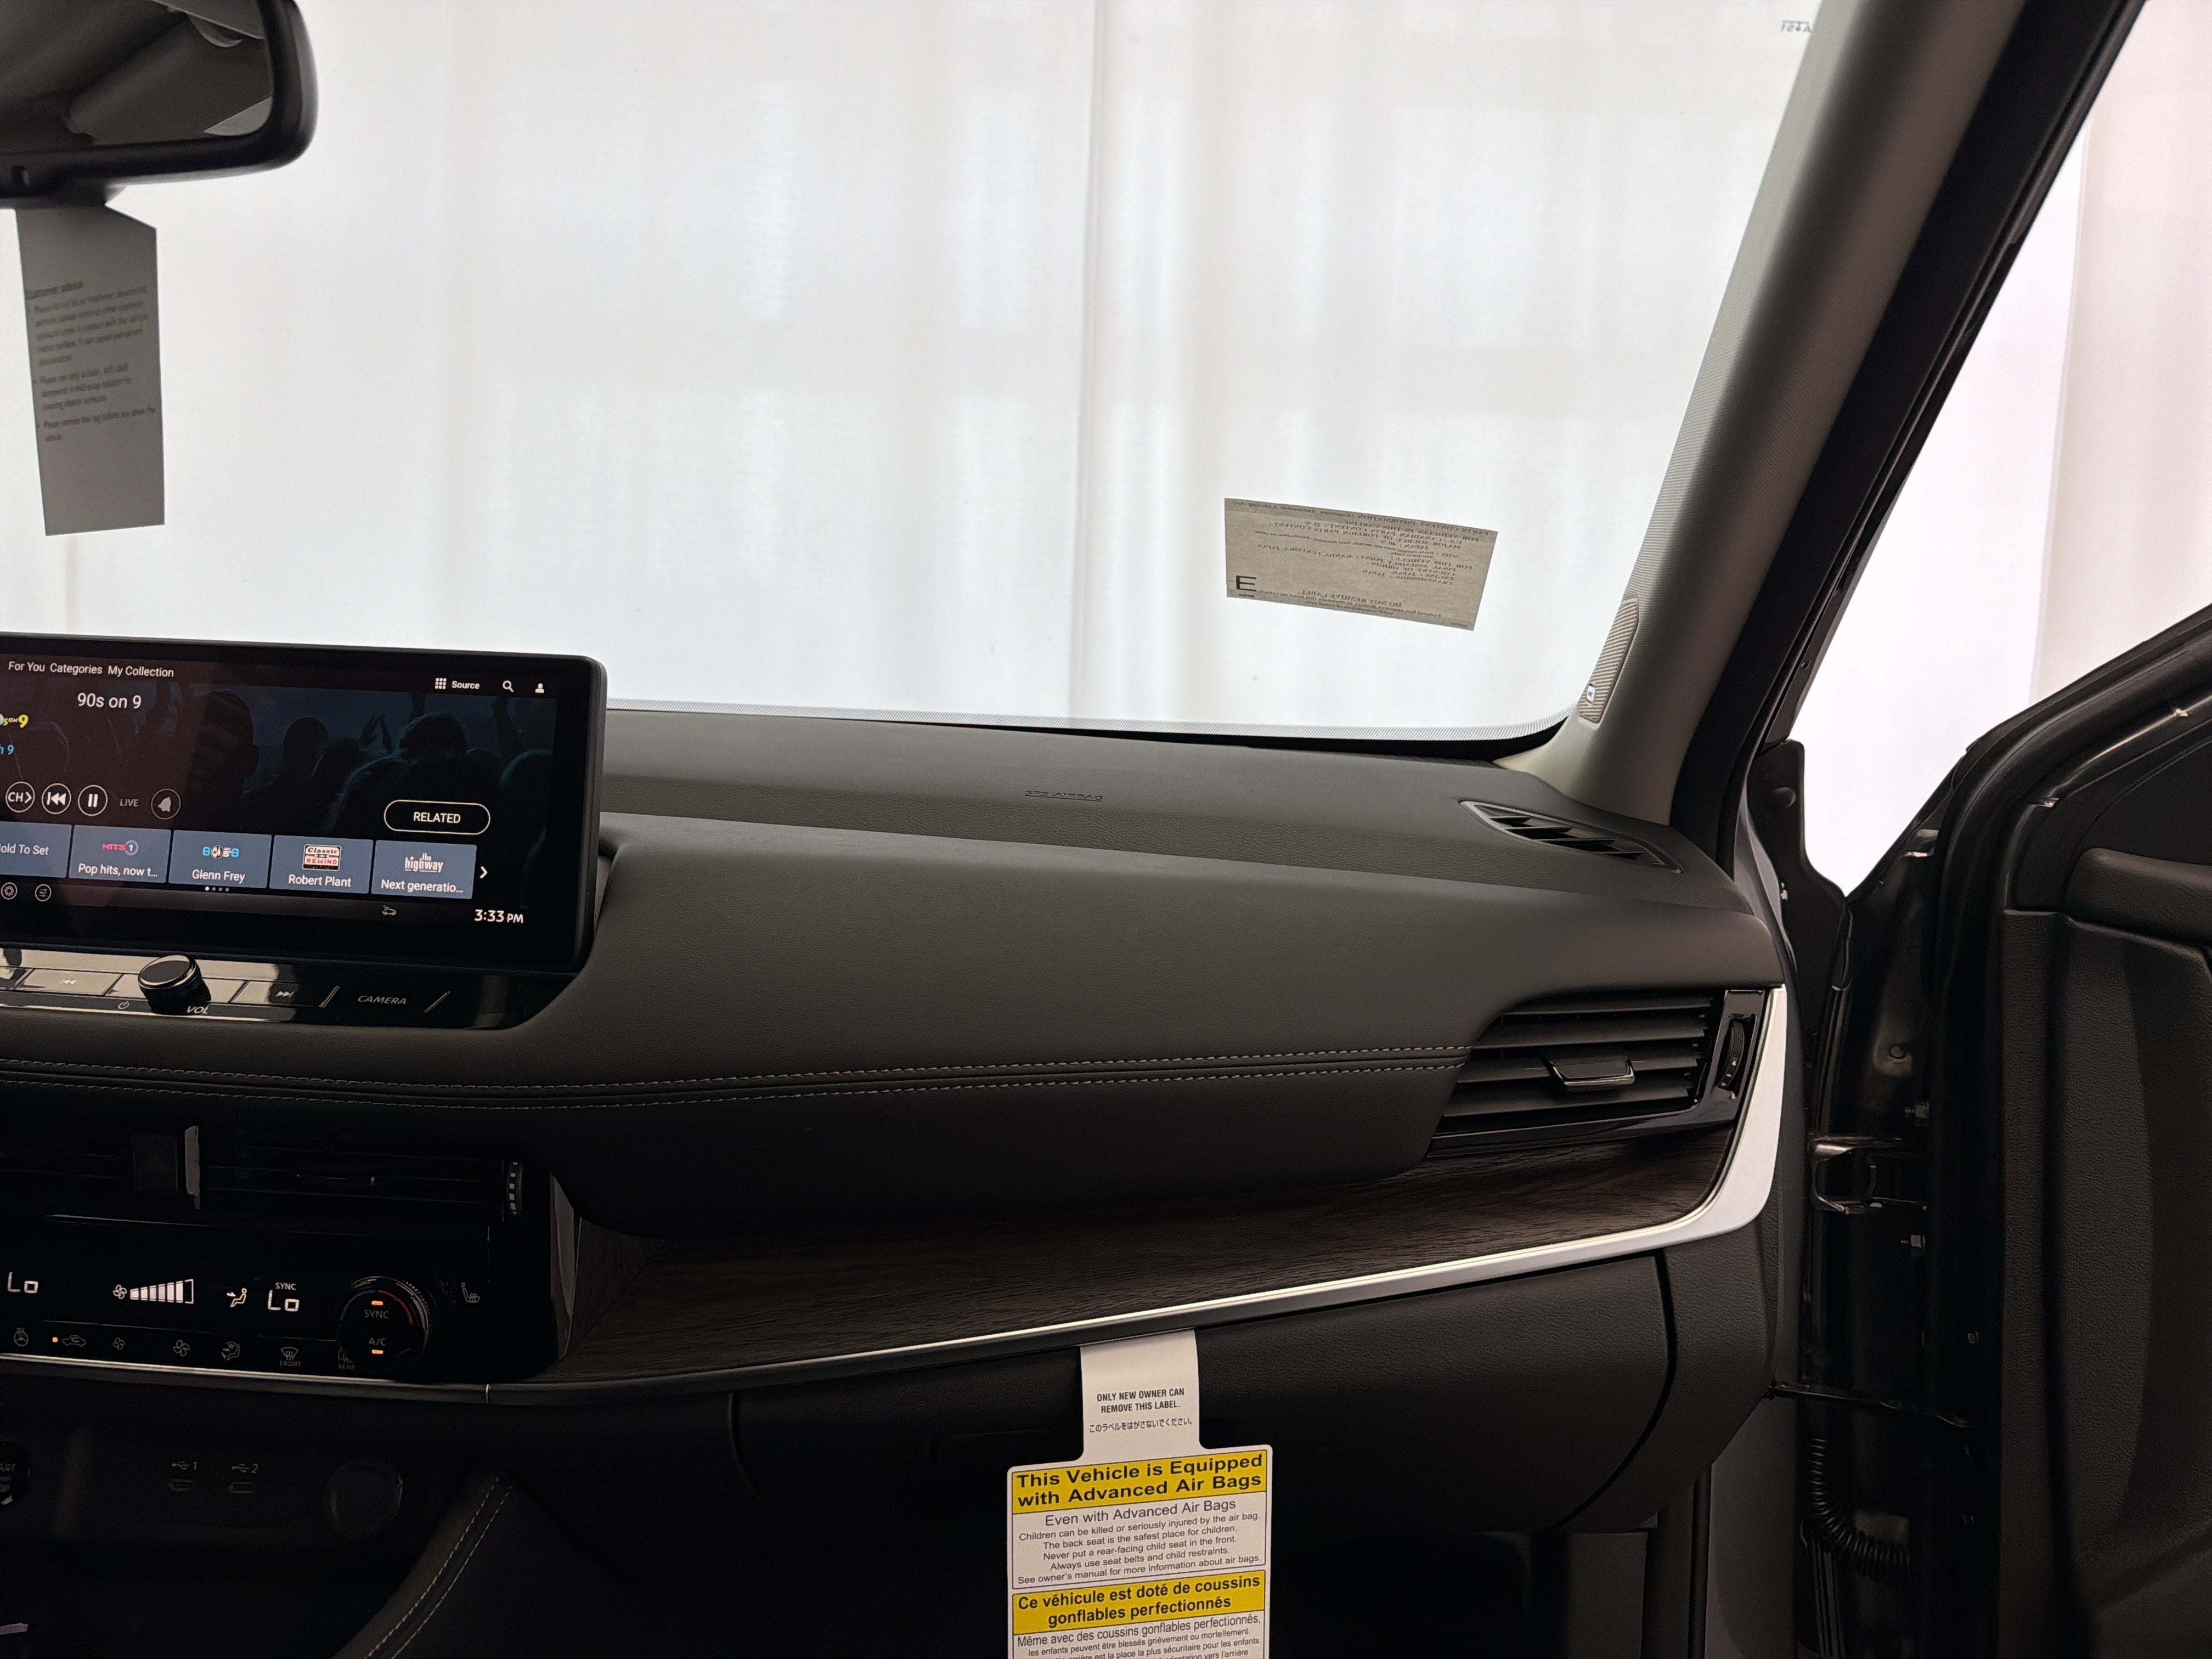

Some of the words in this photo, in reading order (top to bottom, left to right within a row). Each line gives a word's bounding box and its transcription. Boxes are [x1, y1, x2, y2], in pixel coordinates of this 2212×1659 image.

[8, 661, 24, 671] For
[27, 662, 45, 672] You
[50, 663, 103, 675] Categories
[108, 665, 123, 678] My
[125, 666, 174, 677] Collection
[452, 680, 479, 691] Source
[78, 693, 104, 707] 90s
[109, 697, 127, 708] on
[132, 695, 142, 709] 9
[7, 744, 14, 754] 9
[8, 792, 24, 803] CH
[120, 799, 139, 807] LIVE
[413, 811, 461, 823] RELATED
[0, 843, 16, 853] old
[19, 844, 30, 854] To
[33, 845, 49, 855] Set
[422, 853, 432, 861] the
[78, 864, 97, 876] Pop
[100, 864, 121, 876] hits,
[123, 868, 144, 876] now
[405, 856, 443, 873] highway
[192, 869, 221, 880] Glenn
[224, 871, 245, 884] Frey
[289, 874, 322, 885] Robert
[325, 876, 351, 887] Plant
[381, 879, 405, 890] Next
[475, 909, 504, 922] 3:33
[507, 913, 523, 923] PM
[358, 995, 407, 1005] CAMERA
[187, 1006, 209, 1014] VOL
[275, 1282, 297, 1290] SYNC
[364, 1310, 389, 1319] SYNC
[369, 1338, 387, 1346] A/C
[1097, 1392, 1116, 1401] ONLY
[1119, 1391, 1136, 1400] NEW
[1139, 1389, 1166, 1398] OWNER
[1170, 1387, 1184, 1396] CAN
[1101, 1403, 1132, 1413] REMOVE
[1135, 1402, 1152, 1410] THIS
[1155, 1400, 1181, 1409] LABEL.
[1017, 1473, 1060, 1487] This
[1066, 1465, 1139, 1483] Vehicle
[1147, 1464, 1163, 1476] is
[1170, 1454, 1262, 1475] Equipped
[1018, 1491, 1059, 1506] with
[1068, 1481, 1167, 1502] Advanced
[1176, 1479, 1204, 1492] Air
[1213, 1475, 1261, 1489] Bags
[1045, 1515, 1078, 1526] Even
[1082, 1511, 1108, 1522] with
[1113, 1504, 1177, 1520] Advanced
[1182, 1502, 1200, 1514] Air
[1204, 1500, 1235, 1512] Bags
[1019, 1532, 1056, 1541] Children
[1092, 1525, 1113, 1534] killed
[1128, 1521, 1166, 1531] seriously
[1169, 1517, 1197, 1528] injured
[1200, 1515, 1210, 1525] by
[1213, 1514, 1226, 1522] the
[1063, 1539, 1084, 1548] back
[1134, 1532, 1159, 1541] safest
[1162, 1530, 1184, 1540] place
[1201, 1526, 1237, 1534] children.
[1073, 1550, 1086, 1559] put
[1097, 1545, 1143, 1555] rear-facing
[1169, 1541, 1187, 1549] seat
[1051, 1562, 1081, 1571] Always
[1188, 1547, 1229, 1557] restraints.
[1038, 1573, 1072, 1582] owner's
[1075, 1569, 1107, 1578] manual
[1124, 1566, 1146, 1574] more
[1148, 1561, 1195, 1572] information
[1019, 1596, 1038, 1609] Ce
[1042, 1590, 1104, 1607] véhicule
[1110, 1587, 1132, 1600] est
[1137, 1583, 1168, 1598] doté
[1173, 1582, 1190, 1594] de
[1195, 1576, 1260, 1592] coussins
[1048, 1607, 1126, 1628] gonflables
[1131, 1596, 1231, 1620] perfectionnés
[1018, 1635, 1048, 1647] Même
[1051, 1633, 1074, 1644] avec
[1077, 1630, 1094, 1641] des
[1097, 1627, 1139, 1639] coussins
[1142, 1621, 1190, 1637] gonflables
[1194, 1613, 1261, 1632] perfectionnés,
[1071, 1645, 1099, 1654] peuvent
[1118, 1639, 1146, 1648] blessés
[1148, 1634, 1188, 1646] grièvement
[1201, 1628, 1250, 1639] mortellement.
[1116, 1651, 1136, 1659] place
[1138, 1648, 1144, 1656] la
[1147, 1647, 1161, 1657] plus
[1164, 1643, 1200, 1654] sécuritaire
[1203, 1642, 1219, 1652] pour
[1234, 1637, 1261, 1645] enfants.
